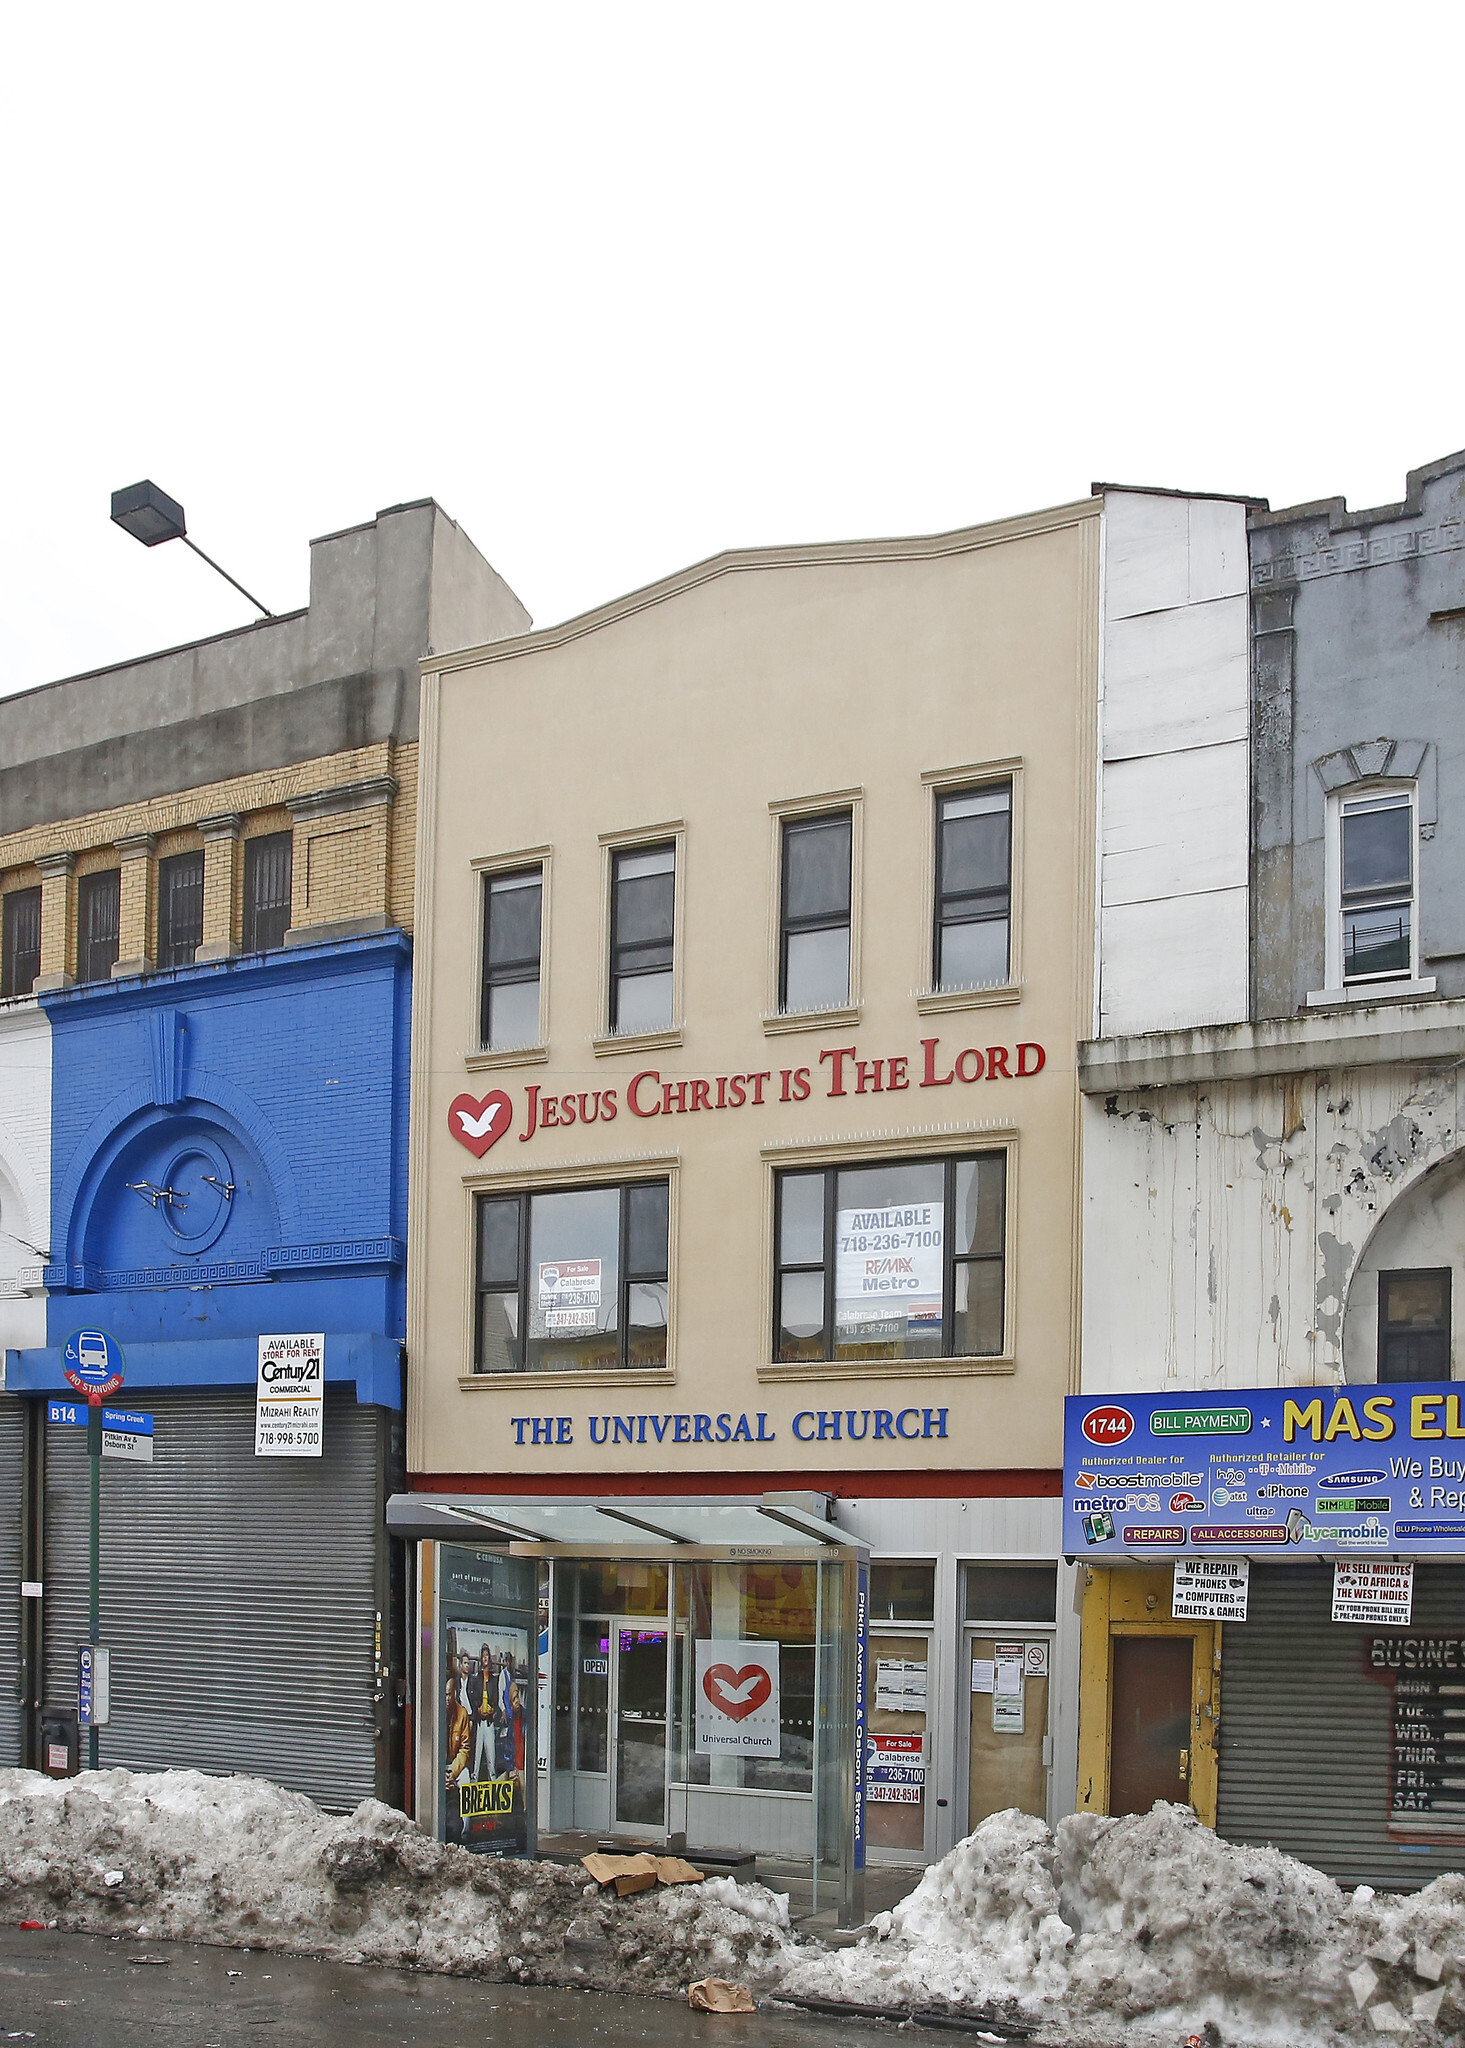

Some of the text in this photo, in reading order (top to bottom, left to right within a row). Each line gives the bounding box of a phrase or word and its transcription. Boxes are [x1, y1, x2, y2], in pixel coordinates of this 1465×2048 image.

[779, 1067, 811, 1102] IS
[852, 1209, 930, 1230] AVAILABLE
[841, 1231, 942, 1252] 718-236-7100
[866, 1257, 913, 1275] RE/MAX
[560, 1278, 595, 1287] Calabrese
[862, 1277, 919, 1291] Metro
[880, 1309, 902, 1320] Team
[860, 1323, 899, 1334] 236-7100
[268, 1338, 315, 1350] AVAILABLE
[262, 1348, 320, 1360] STORE FOR RENT
[69, 1373, 119, 1394] NO STANDING
[269, 1385, 311, 1394] COMMERCIAL
[51, 1406, 76, 1423] B14
[260, 1405, 319, 1417] MIZRAHI REALTY
[105, 1411, 145, 1424] Spring Creek
[1154, 1414, 1248, 1429] BILL PAYMENT
[1283, 1396, 1394, 1441] MAS
[510, 1407, 949, 1445] THE UNIVERSAL CHURCH
[1089, 1418, 1126, 1434] 1744
[104, 1433, 123, 1442] Pitkin
[123, 1435, 132, 1443] Av
[104, 1441, 135, 1450] Osborn St
[1082, 1455, 1185, 1466] Authorized Dealer for
[1209, 1452, 1325, 1463] Authorized Retailer for
[1390, 1456, 1465, 1483] We Buy
[1327, 1474, 1378, 1484] SAMSUNG
[1267, 1485, 1308, 1497] iPhone
[1409, 1486, 1424, 1508] &
[1074, 1494, 1160, 1511] metroPCS
[1319, 1499, 1388, 1510] SIMPLE Mobile
[1133, 1530, 1180, 1539] REPAIRS
[1198, 1529, 1285, 1538] ALL ACCESSORIES
[1305, 1525, 1388, 1540] Lycamobile
[1396, 1525, 1410, 1533] BLU
[1411, 1525, 1432, 1533] Phone
[1185, 1562, 1238, 1576] WE REPAIR
[1337, 1562, 1411, 1576] WE SELL MINUTES
[452, 1572, 464, 1580] part
[1195, 1578, 1227, 1589] PHONES
[1358, 1576, 1409, 1589] TO AFRICA &
[1185, 1591, 1235, 1603] COMPUTERS
[1336, 1587, 1408, 1601] THE WEST INDIES
[1174, 1604, 1245, 1619] TABLETS & GAMES
[1362, 1605, 1380, 1613] PHONE
[1381, 1606, 1393, 1614] BILL
[1340, 1612, 1365, 1620] PRE-PAID
[1365, 1614, 1388, 1622] PHONES
[1388, 1615, 1403, 1623] ONLY
[585, 1660, 606, 1672] OPEN
[853, 1592, 865, 1841] Pitkin Avenue & Osborn Street
[702, 1734, 772, 1746] Universal Church
[885, 1740, 897, 1748] For
[898, 1740, 913, 1748] Sale
[878, 1752, 921, 1763] Calabrese
[888, 1767, 924, 1783] 236-7100
[461, 1783, 512, 1815] BREAKS
[873, 1786, 919, 1802] 347-242-8514
